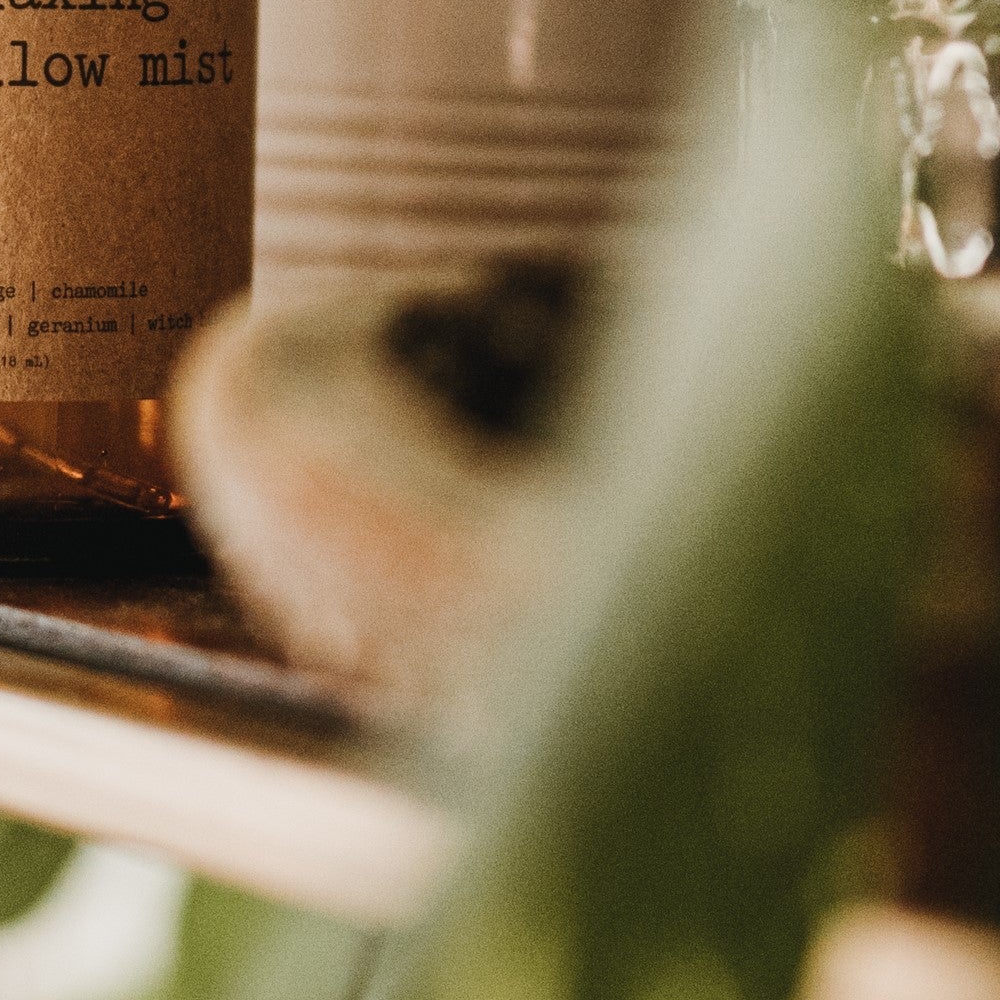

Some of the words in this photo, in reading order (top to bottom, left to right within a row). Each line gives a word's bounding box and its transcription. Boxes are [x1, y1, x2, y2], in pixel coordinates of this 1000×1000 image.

[138, 38, 234, 87] mist
[51, 282, 149, 299] chamomile
[27, 317, 119, 337] geranium
[147, 312, 193, 331] witch
